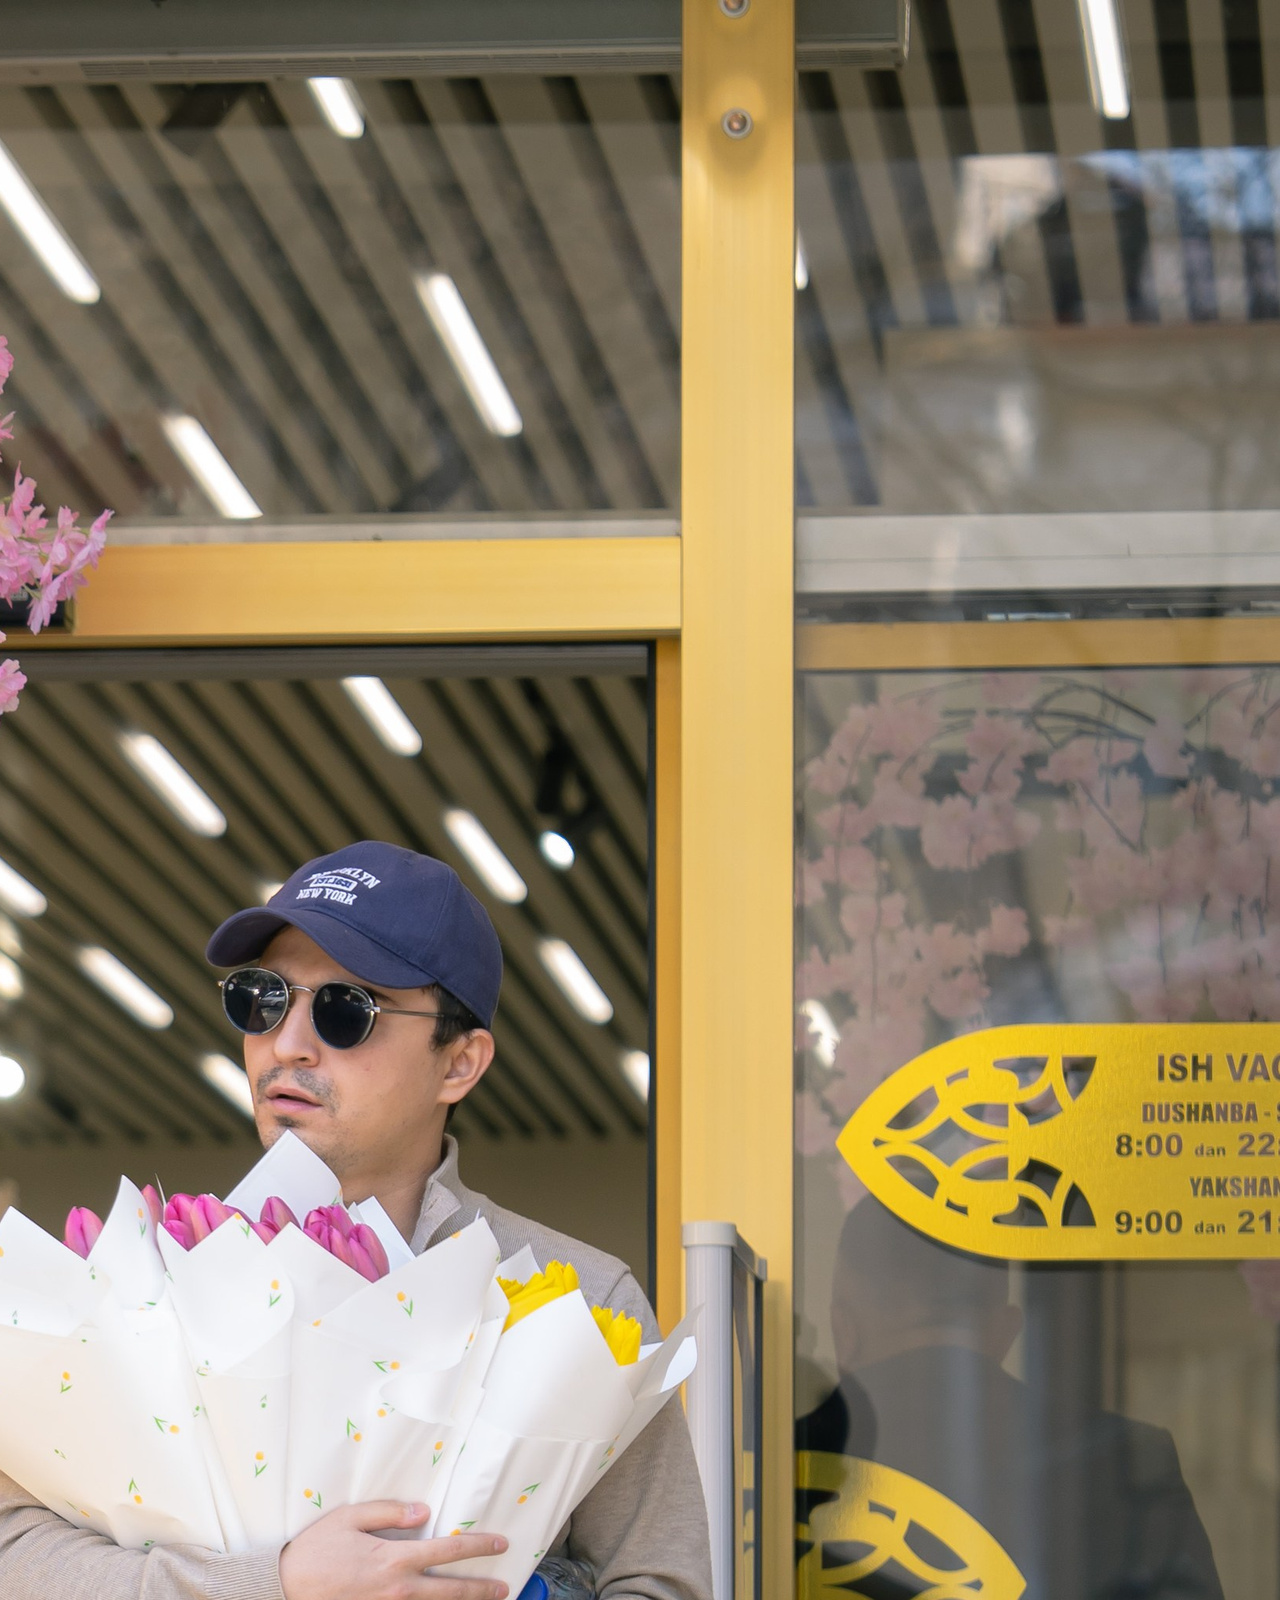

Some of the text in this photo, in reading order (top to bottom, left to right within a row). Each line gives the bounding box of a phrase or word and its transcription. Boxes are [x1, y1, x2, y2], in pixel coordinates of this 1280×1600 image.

[296, 887, 358, 905] NEW YORK
[1157, 1053, 1213, 1082] ISH
[1141, 1101, 1258, 1123] DUSHANBA
[1115, 1133, 1280, 1157] 8:00 dan 22
[1115, 1210, 1280, 1234] 9:00 dan 21
